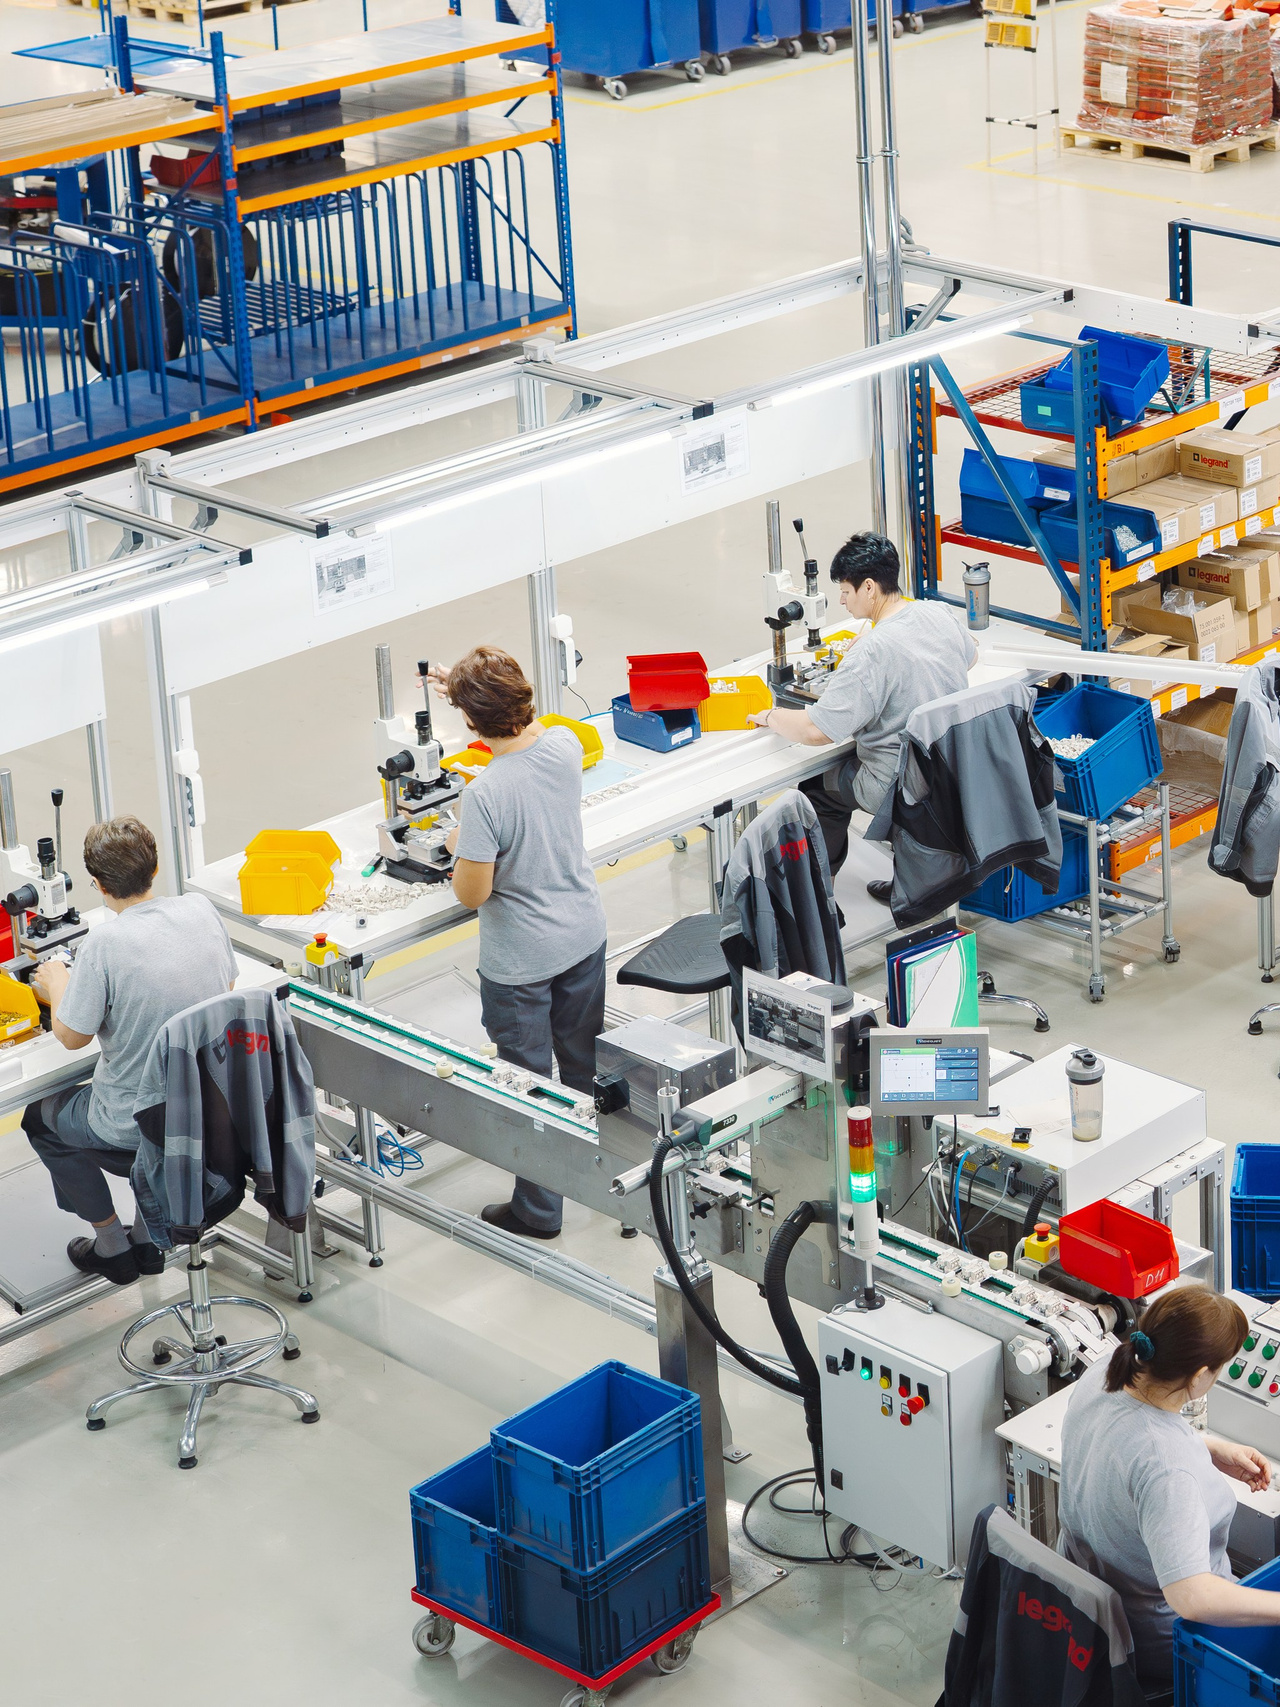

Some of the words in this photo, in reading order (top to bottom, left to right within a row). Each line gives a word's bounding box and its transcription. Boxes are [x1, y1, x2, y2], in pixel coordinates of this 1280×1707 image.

[1200, 454, 1229, 468] legrand
[1197, 568, 1230, 584] legrand
[723, 1116, 735, 1127] 7330
